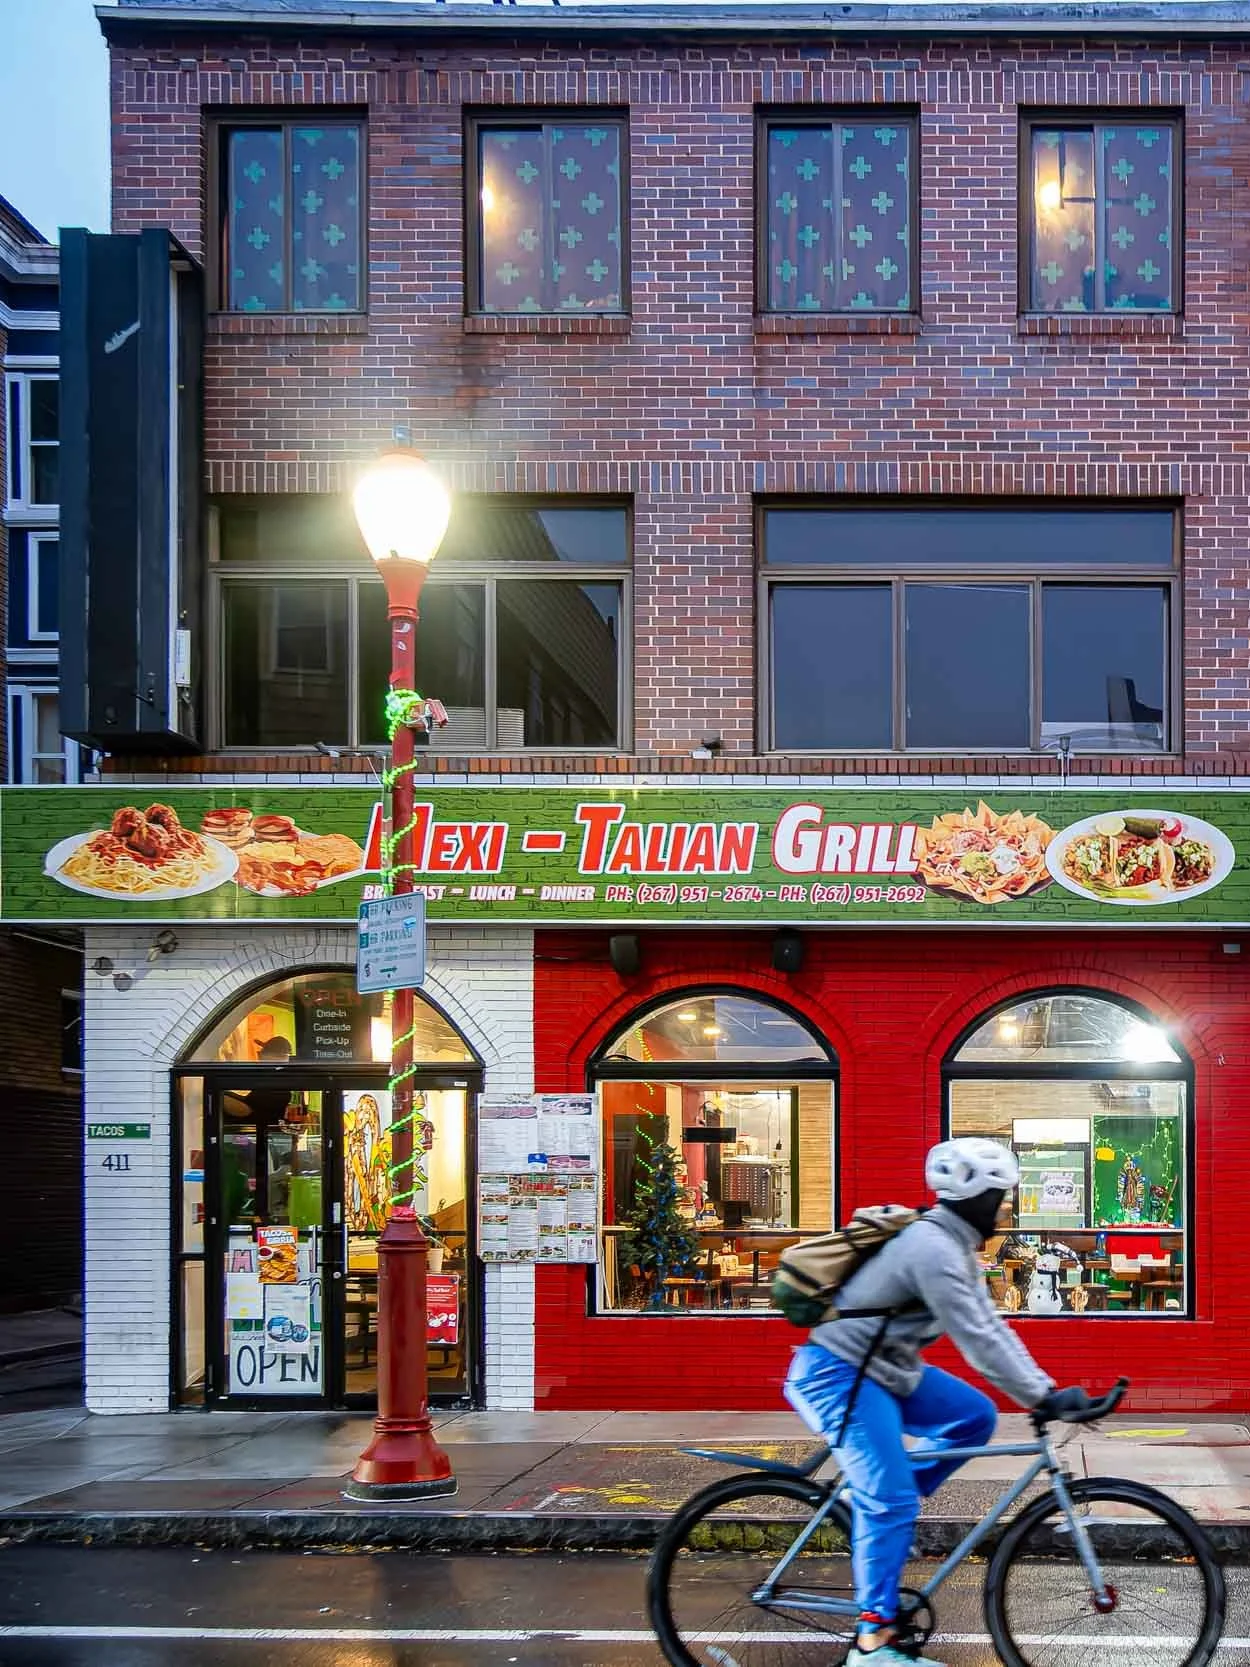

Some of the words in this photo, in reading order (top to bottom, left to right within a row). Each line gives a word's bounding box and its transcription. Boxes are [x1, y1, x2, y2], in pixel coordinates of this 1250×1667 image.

[576, 803, 759, 874] TALIAN
[772, 802, 922, 875] GRILL
[470, 885, 517, 900] LUNCH
[540, 886, 595, 901] DINNER
[606, 886, 634, 901] PH:
[637, 883, 677, 904] (267)
[680, 887, 708, 901] 951
[725, 887, 762, 902] 2674
[780, 886, 807, 901] PH:
[810, 883, 850, 904] (267)
[854, 886, 926, 903] 951-2692
[313, 1023, 351, 1031] Curbside
[89, 1126, 125, 1136] TACOS
[102, 1154, 131, 1171] 411
[237, 1345, 320, 1387] OPEN
